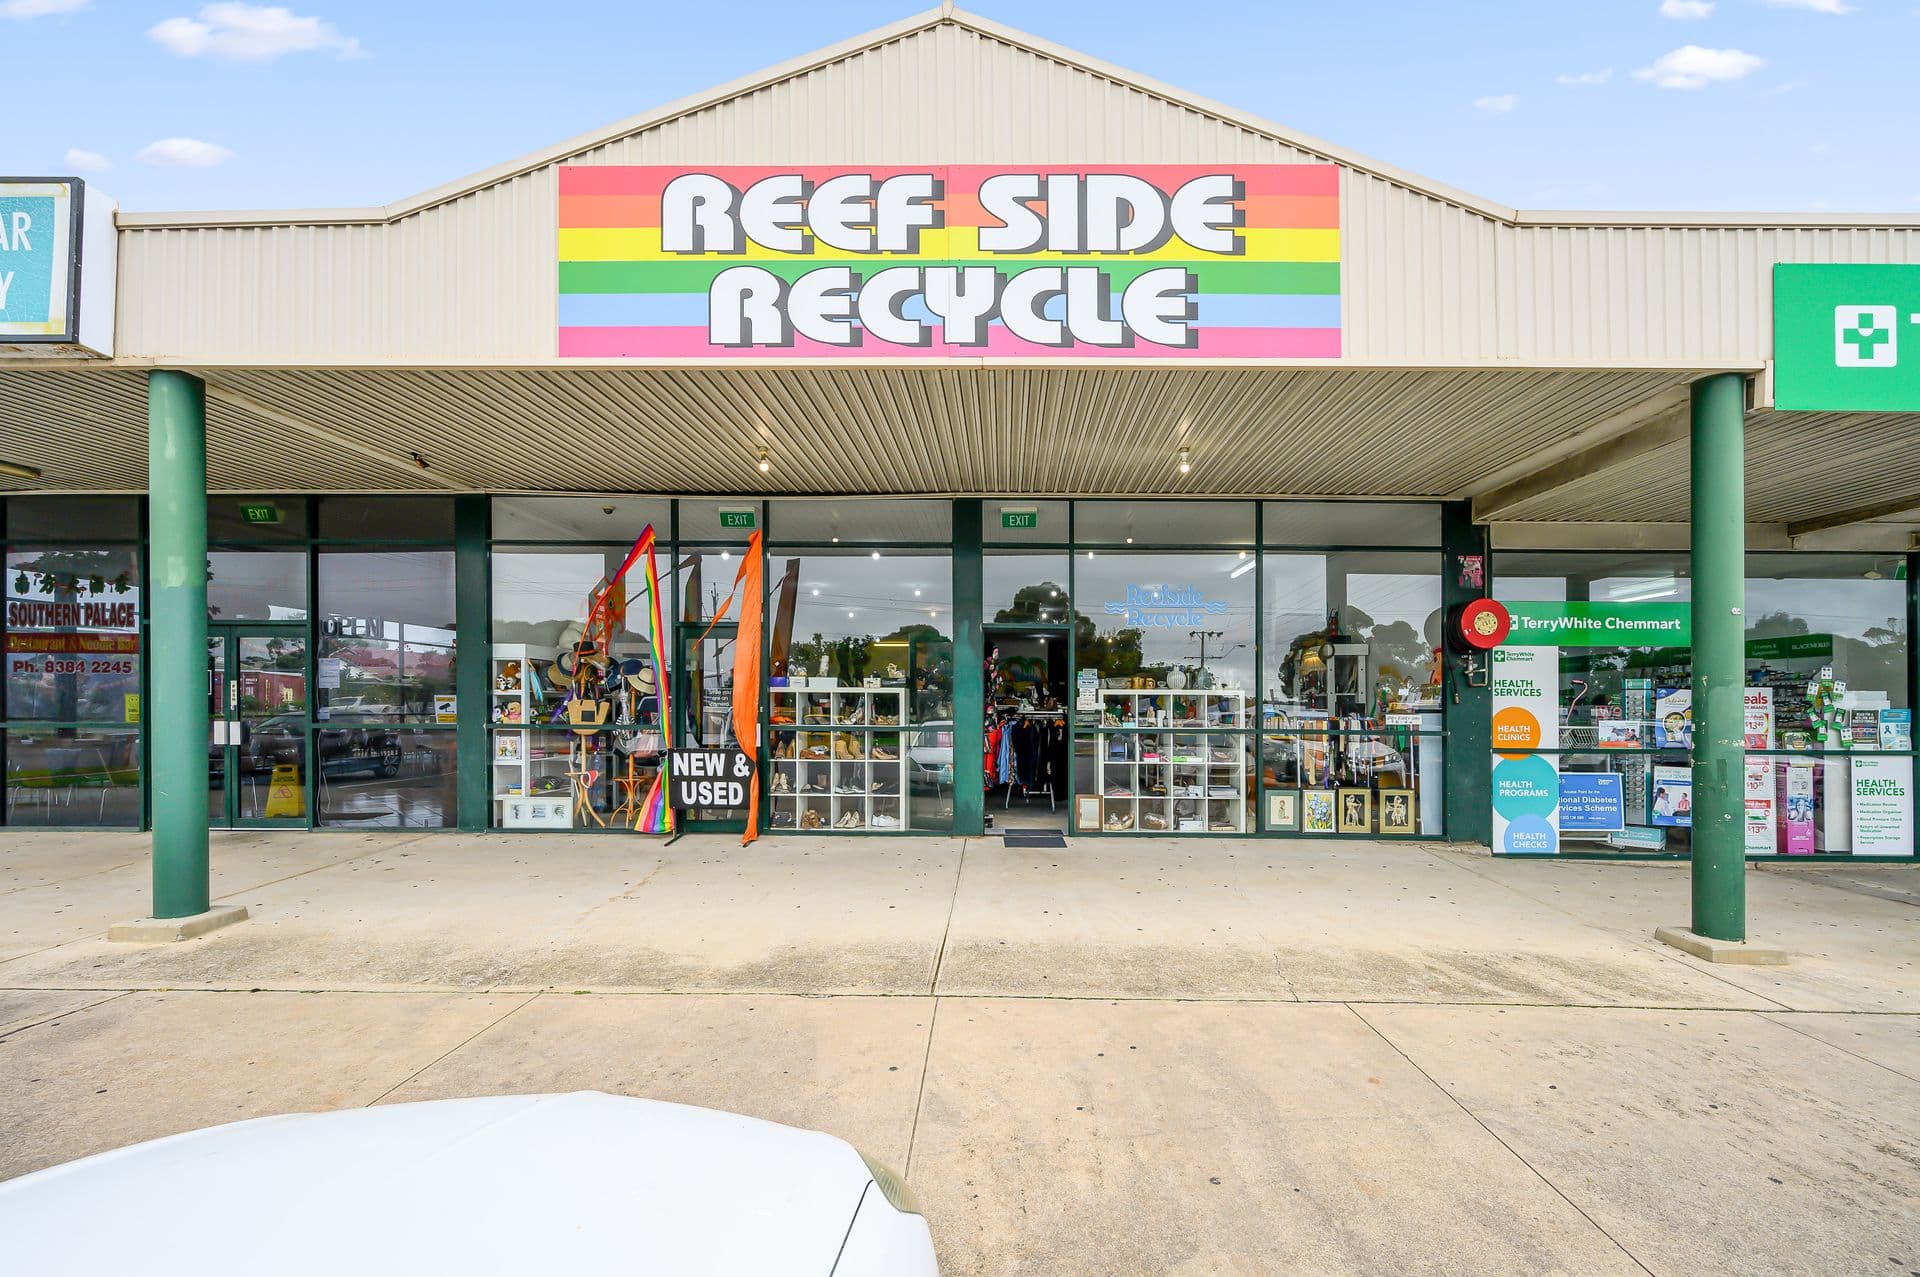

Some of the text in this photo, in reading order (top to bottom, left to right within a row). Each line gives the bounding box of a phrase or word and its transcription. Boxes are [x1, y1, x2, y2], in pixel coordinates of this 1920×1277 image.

[661, 174, 1246, 256] REEF SIDE
[709, 266, 1198, 348] RECYCLE
[248, 508, 269, 520] EXIT
[727, 514, 748, 526] EXIT
[1009, 515, 1030, 526] EXIT
[8, 602, 136, 627] SOUTHERN PALACE
[1127, 607, 1204, 630] Recycle
[321, 616, 384, 639] OPEN
[1521, 616, 1681, 632] TerryWhite Chemmart
[13, 660, 132, 673] Ph. 8384 2245
[1494, 679, 1533, 688] HEALTH
[1494, 688, 1542, 697] SERVICES
[1497, 725, 1531, 733] HEALTH
[1497, 733, 1531, 741] CLINICS
[673, 752, 751, 777] NEW &
[1499, 780, 1533, 788] HEALTH
[1856, 779, 1896, 787] HEALTH
[681, 781, 744, 805] USED
[1499, 789, 1549, 797] PROGRAMS
[1856, 787, 1905, 796] SERVICES
[1582, 796, 1618, 804] Diabetes
[1584, 804, 1618, 812] Scheme
[1512, 832, 1546, 840] HEALTH
[1512, 840, 1548, 848] CHECKS
